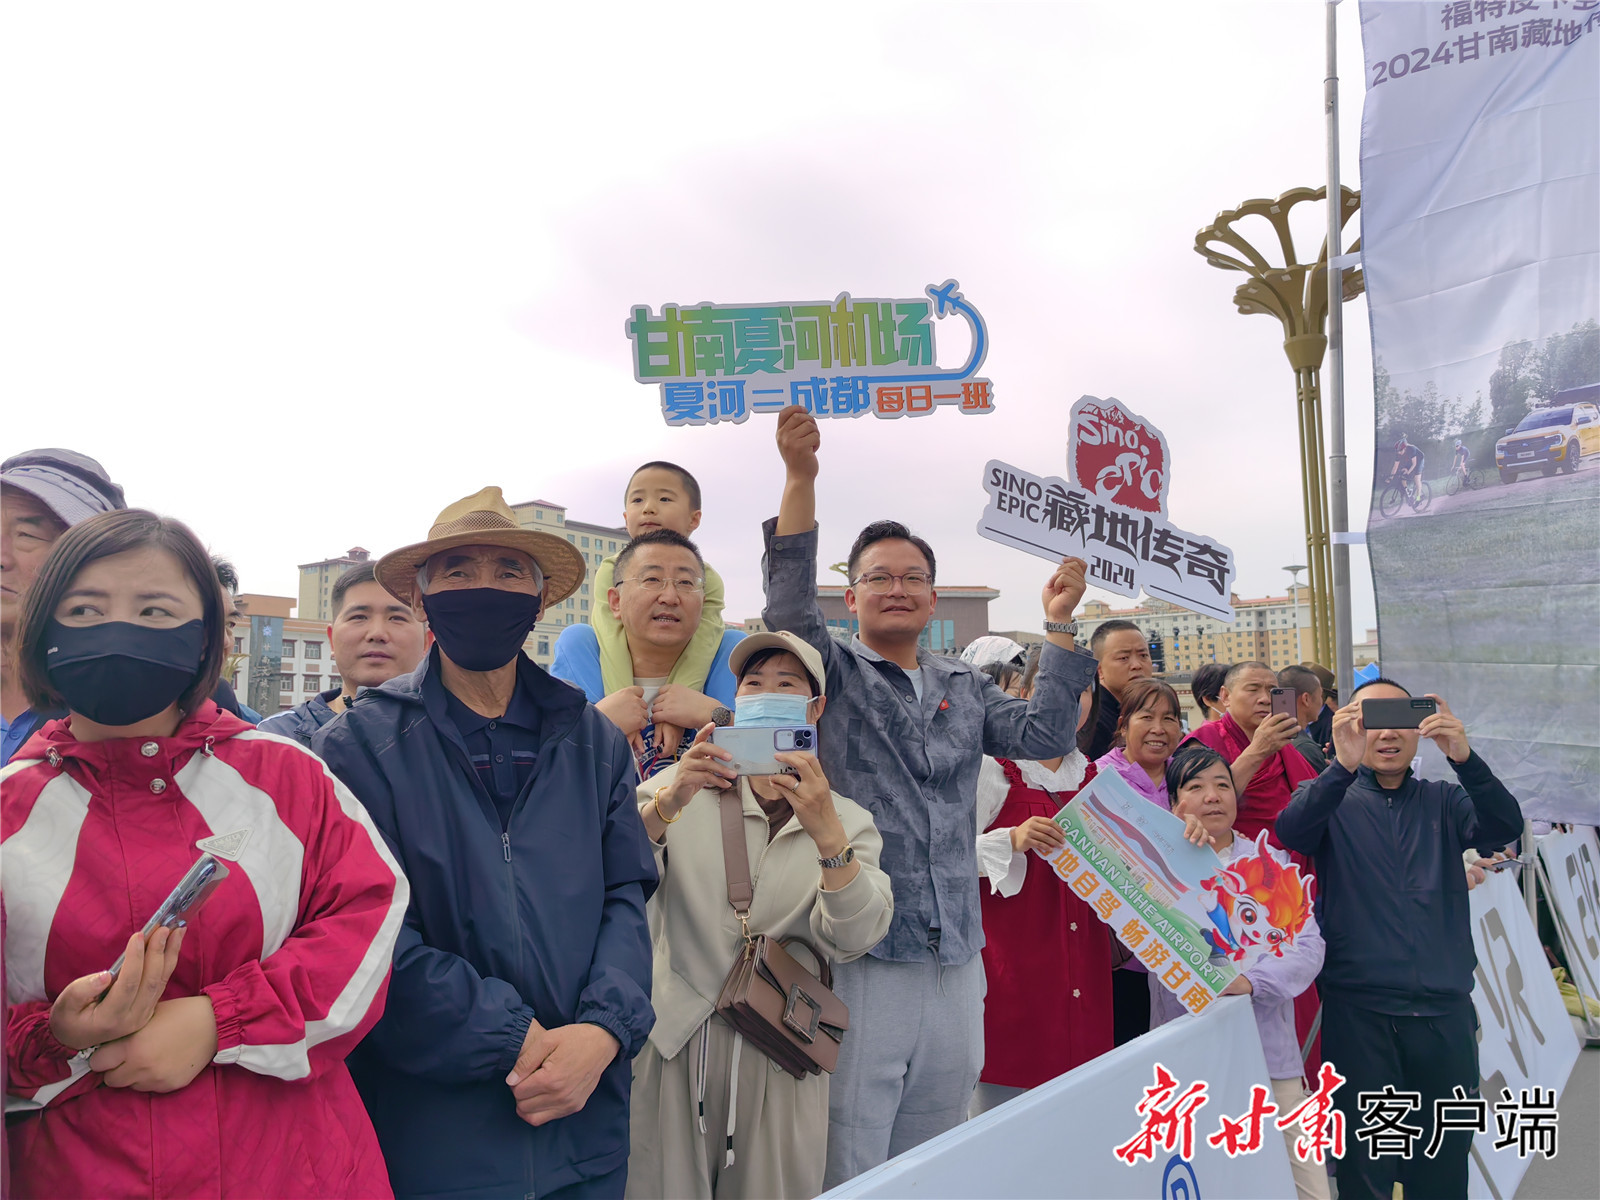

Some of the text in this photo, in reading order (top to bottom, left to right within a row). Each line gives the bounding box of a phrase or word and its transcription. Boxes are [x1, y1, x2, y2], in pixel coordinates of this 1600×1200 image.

[630, 297, 932, 377] 甘南夏河机场
[876, 382, 991, 413] 每日一班
[1077, 414, 1139, 448] Sino
[990, 467, 1042, 501] SINO
[997, 491, 1042, 523] EPIC
[1041, 484, 1230, 595] 藏地传奇
[1090, 554, 1135, 589] 2024
[1058, 817, 1121, 881] GANNAN
[1119, 880, 1158, 919] XIHE
[1156, 917, 1225, 986] AIRPORT
[1036, 847, 1214, 1014] 地自驾 畅游甘南
